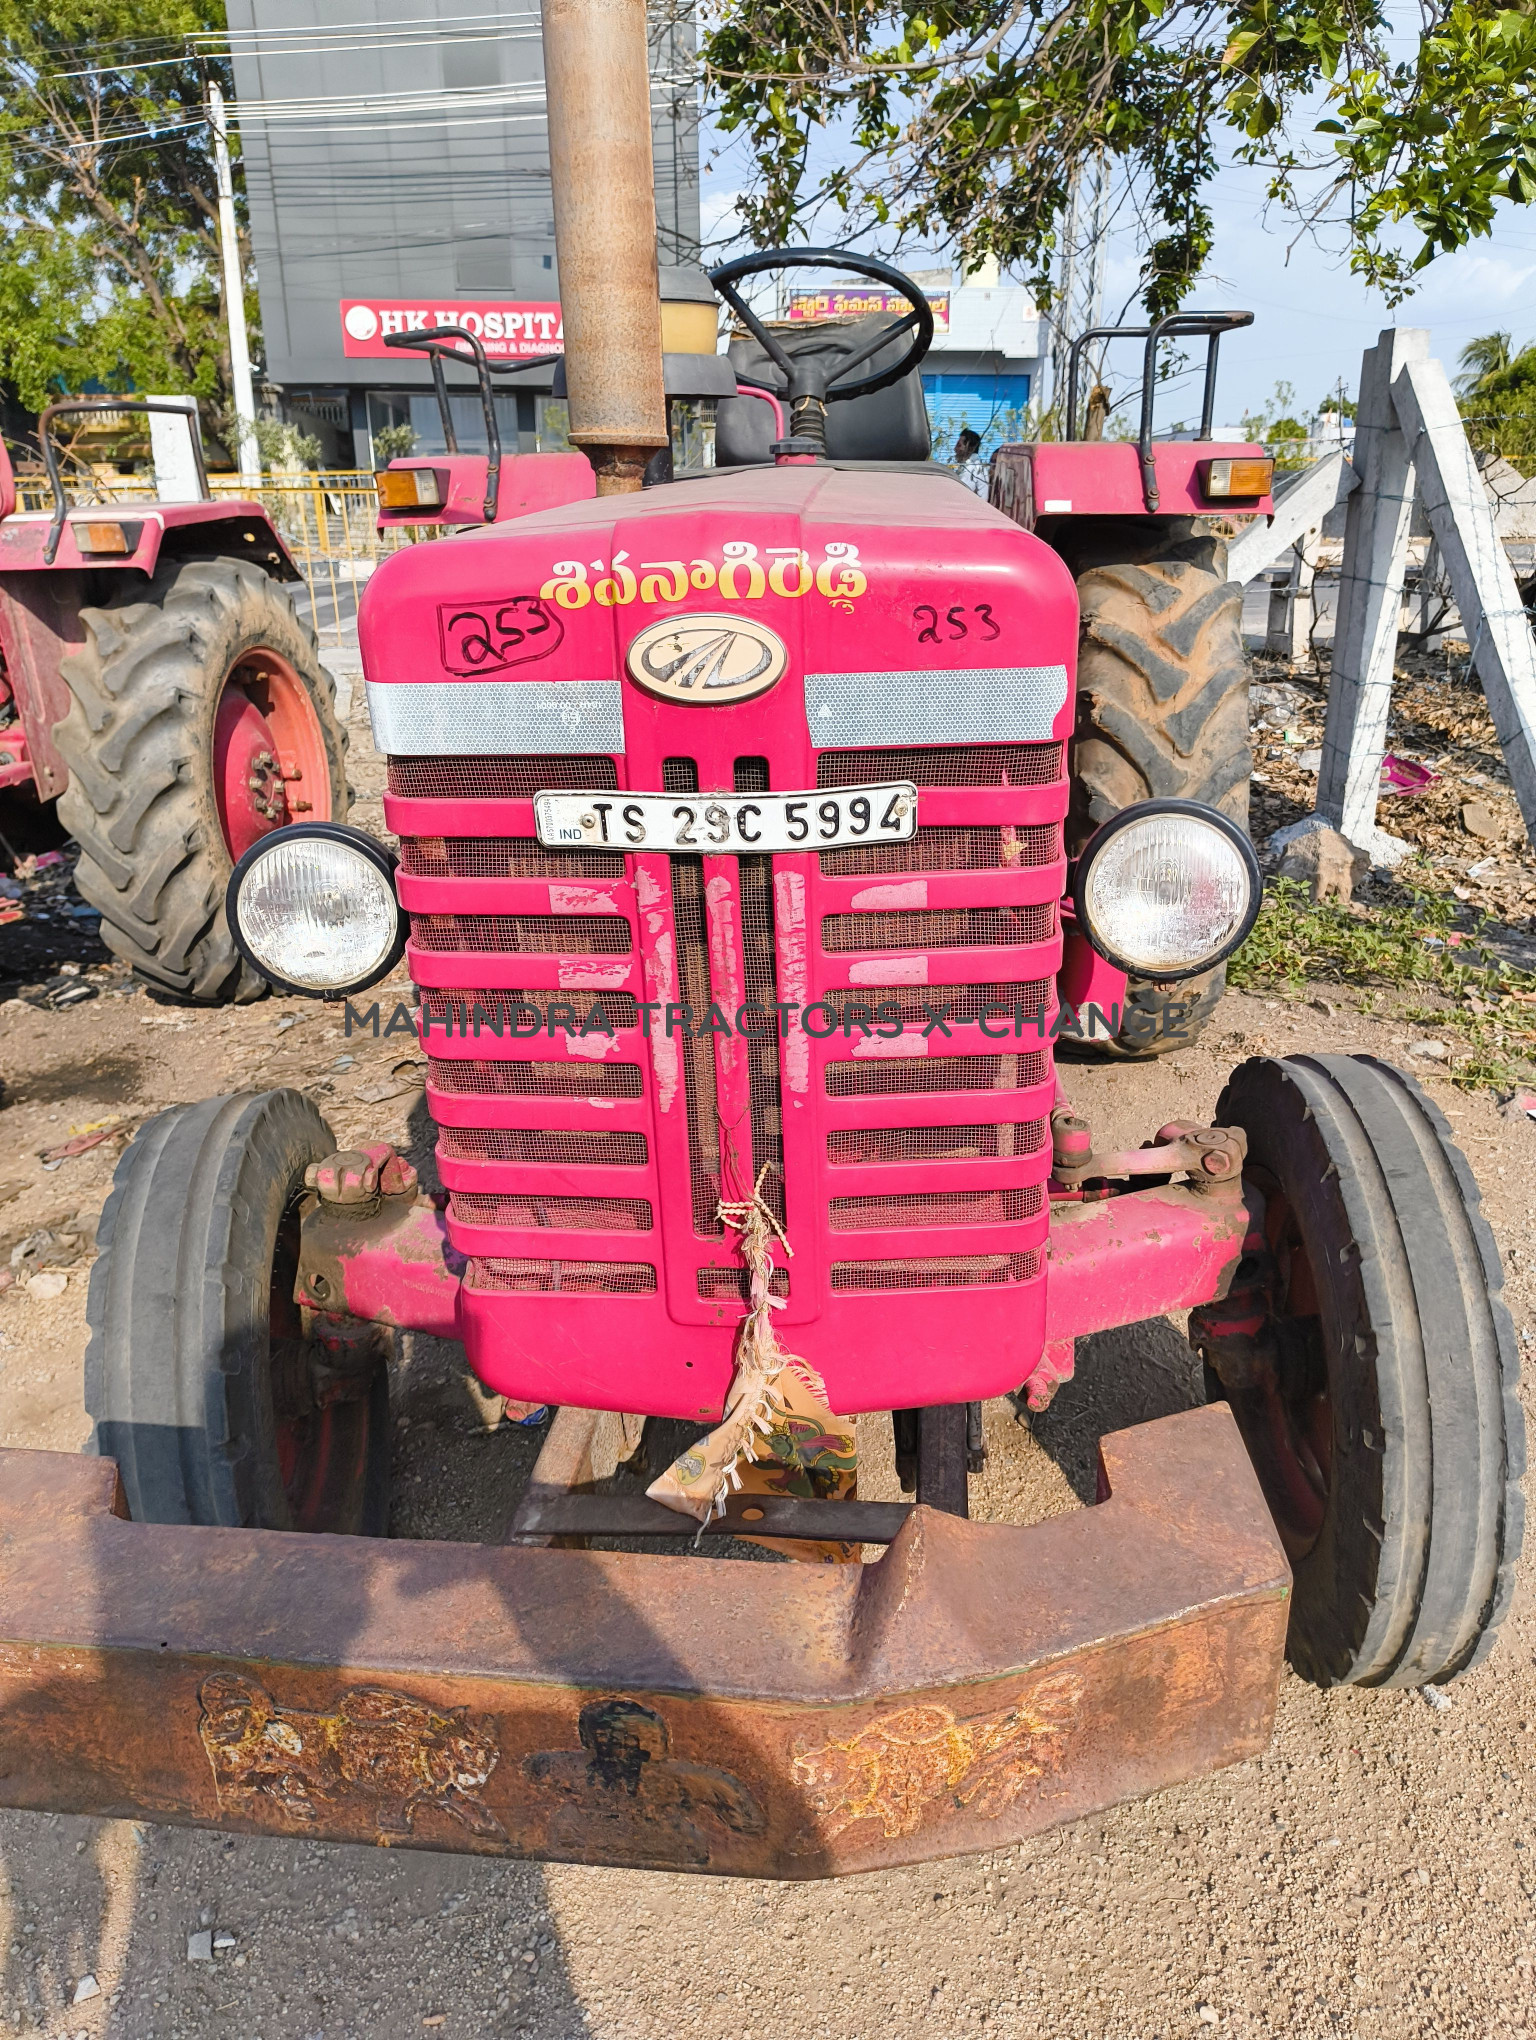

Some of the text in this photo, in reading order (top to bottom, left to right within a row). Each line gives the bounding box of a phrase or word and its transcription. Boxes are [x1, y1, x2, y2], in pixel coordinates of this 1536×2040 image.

[379, 310, 564, 340] HK HOSPIT
[509, 342, 517, 353] &
[448, 597, 552, 664] 253
[917, 605, 999, 643] 253
[559, 828, 582, 840] IND
[593, 803, 646, 842] TS
[785, 793, 902, 842] 5994
